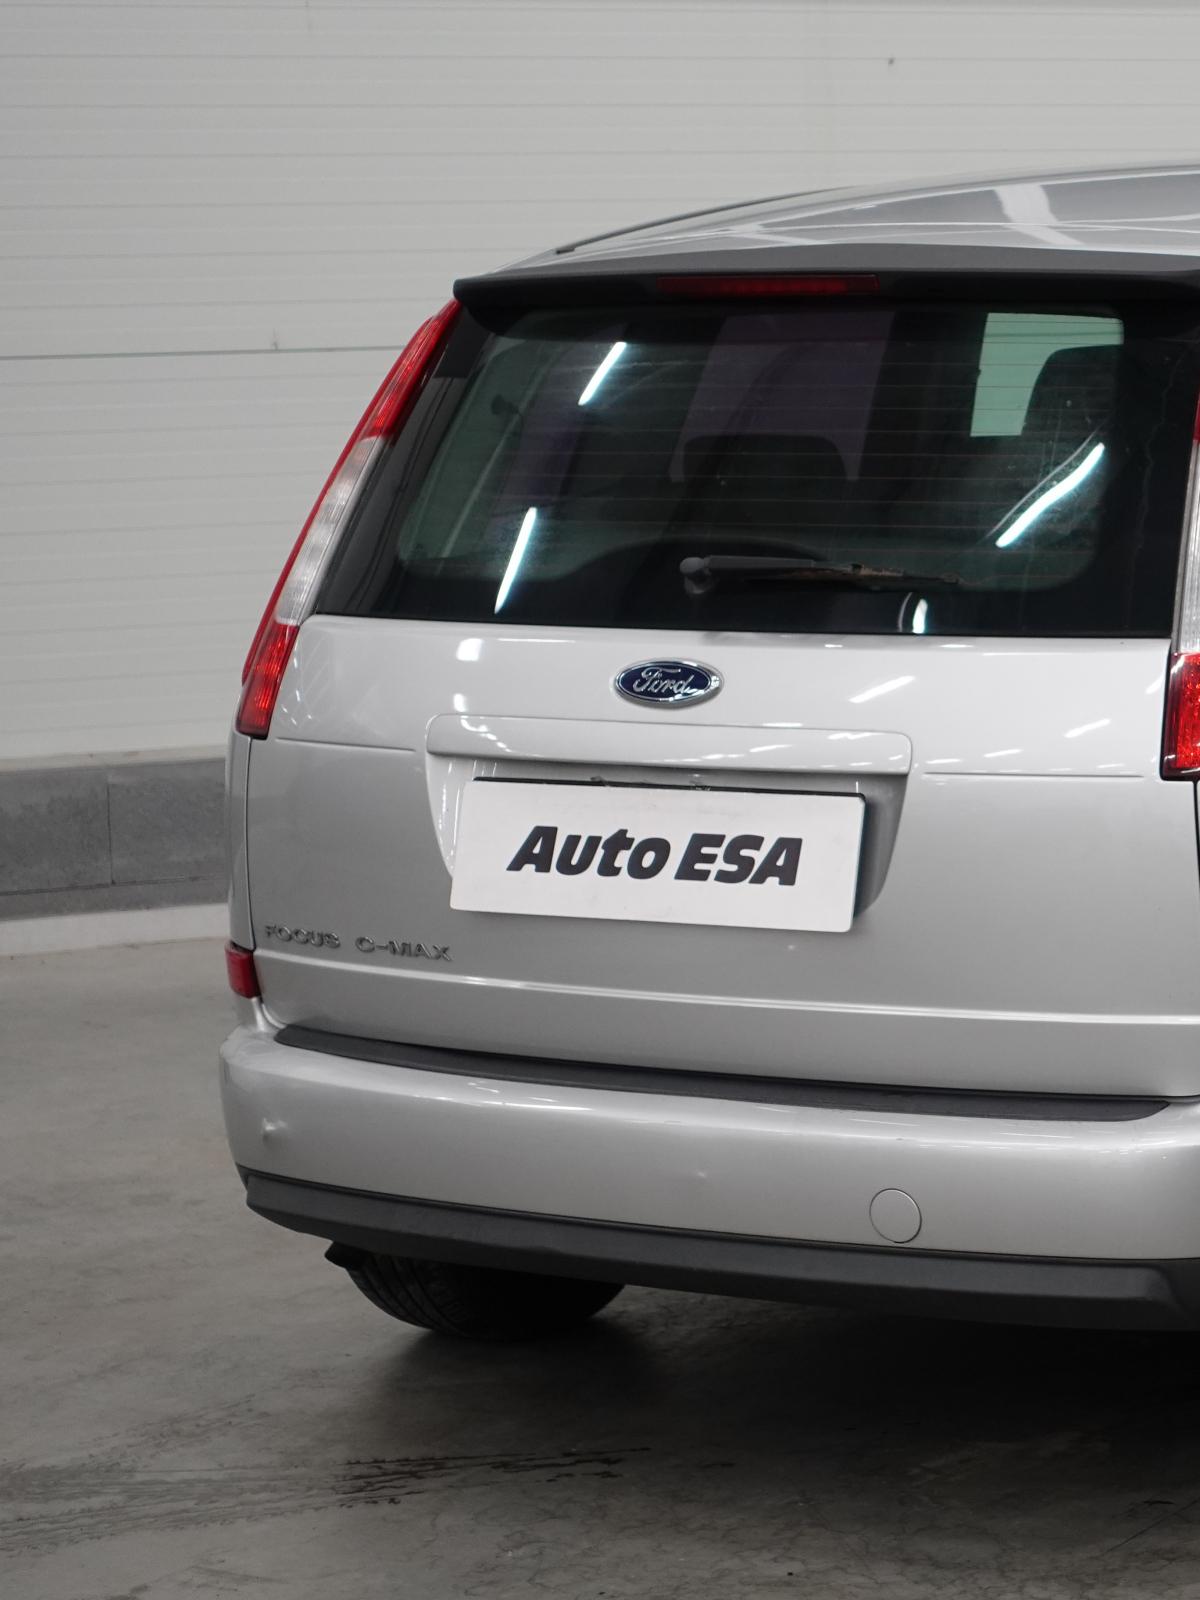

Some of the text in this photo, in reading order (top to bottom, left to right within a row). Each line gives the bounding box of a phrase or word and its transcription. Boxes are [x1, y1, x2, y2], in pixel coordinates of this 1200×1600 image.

[633, 666, 698, 693] Ford
[506, 825, 803, 886] Auto ESA
[265, 925, 452, 961] FOCUS C-MAX
